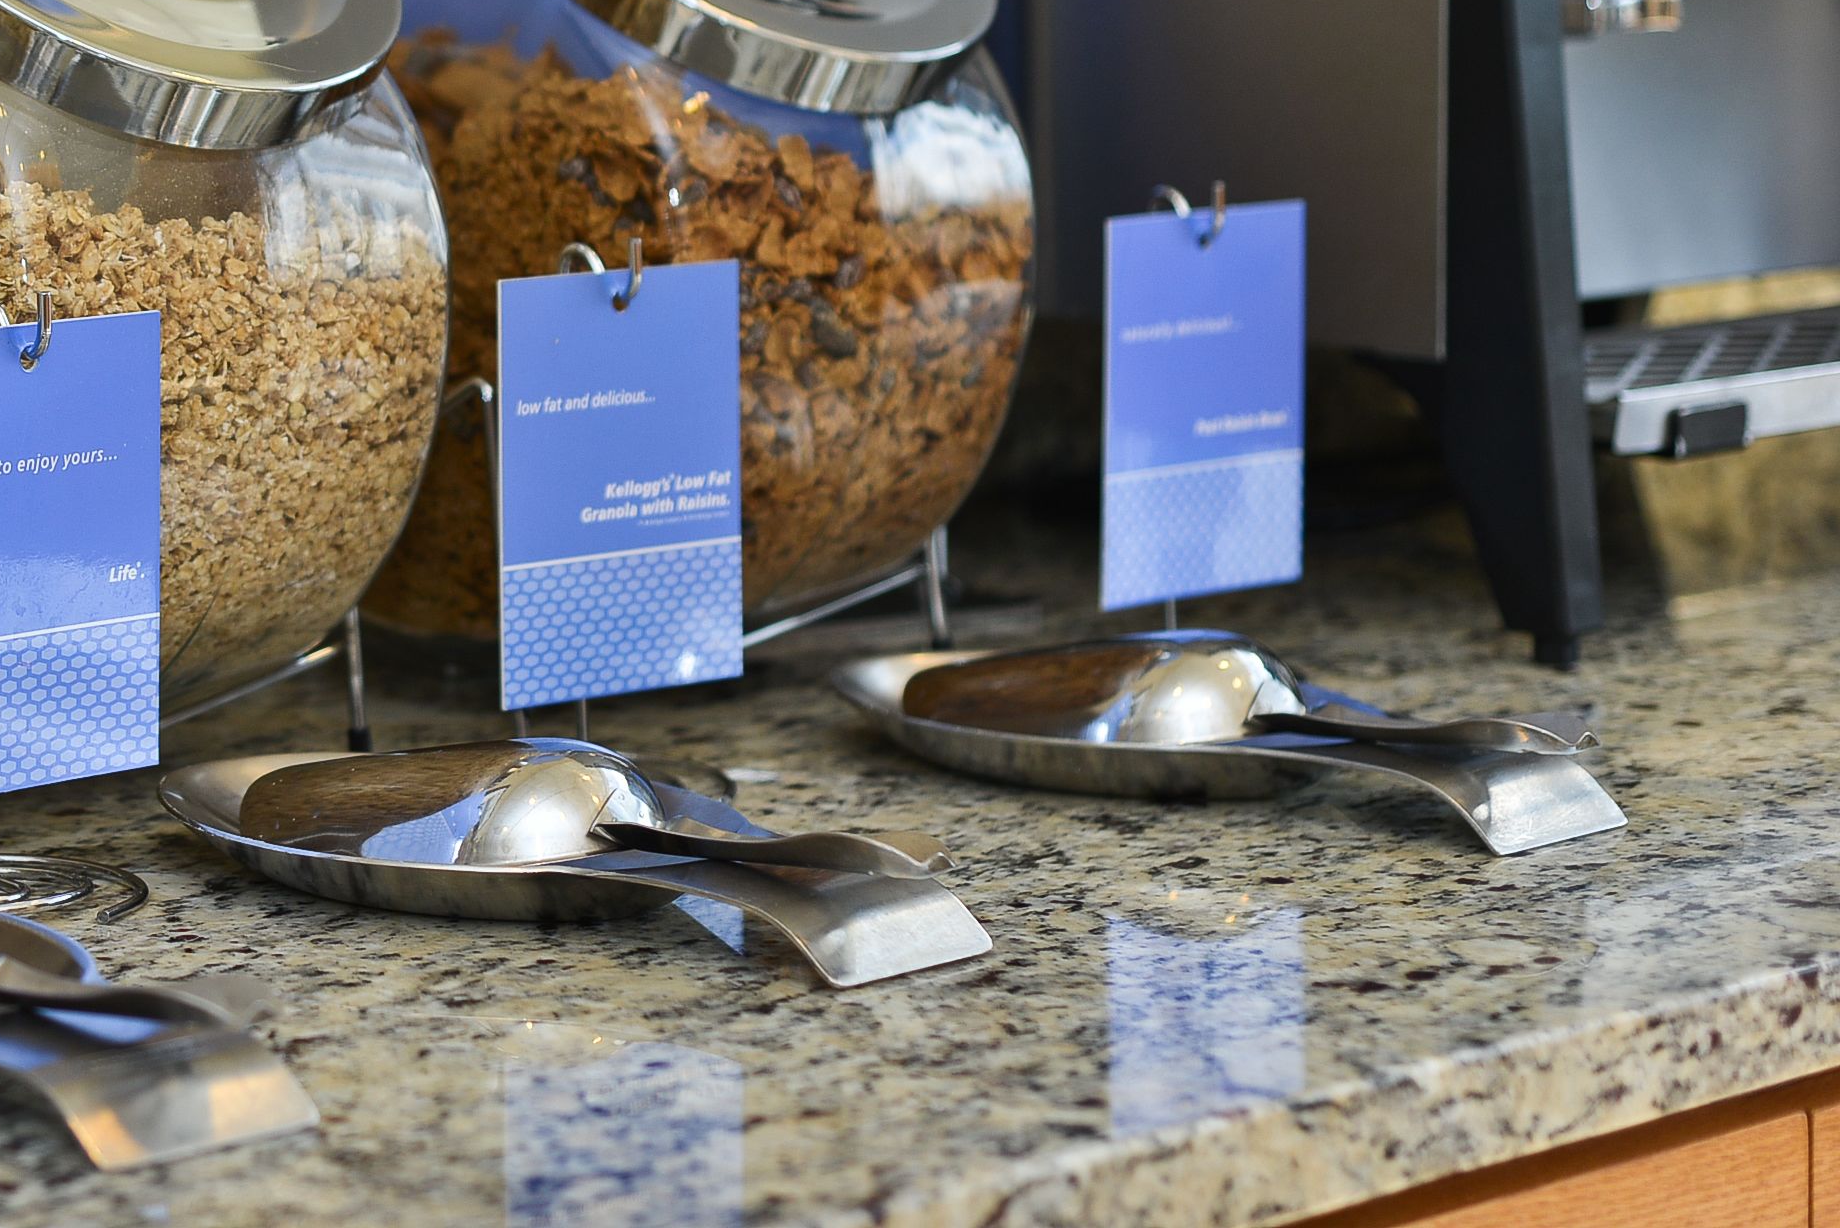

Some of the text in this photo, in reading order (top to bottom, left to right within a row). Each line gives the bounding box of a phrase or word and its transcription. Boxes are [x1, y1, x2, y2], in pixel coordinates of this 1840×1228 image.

[516, 390, 655, 416] low fat and delicious...
[18, 454, 58, 473] enjoy
[63, 449, 117, 469] yours...
[675, 474, 706, 491] Low
[707, 469, 733, 486] Fat
[581, 501, 637, 523] Granola
[641, 497, 674, 515] with
[678, 493, 731, 510] Raisins.
